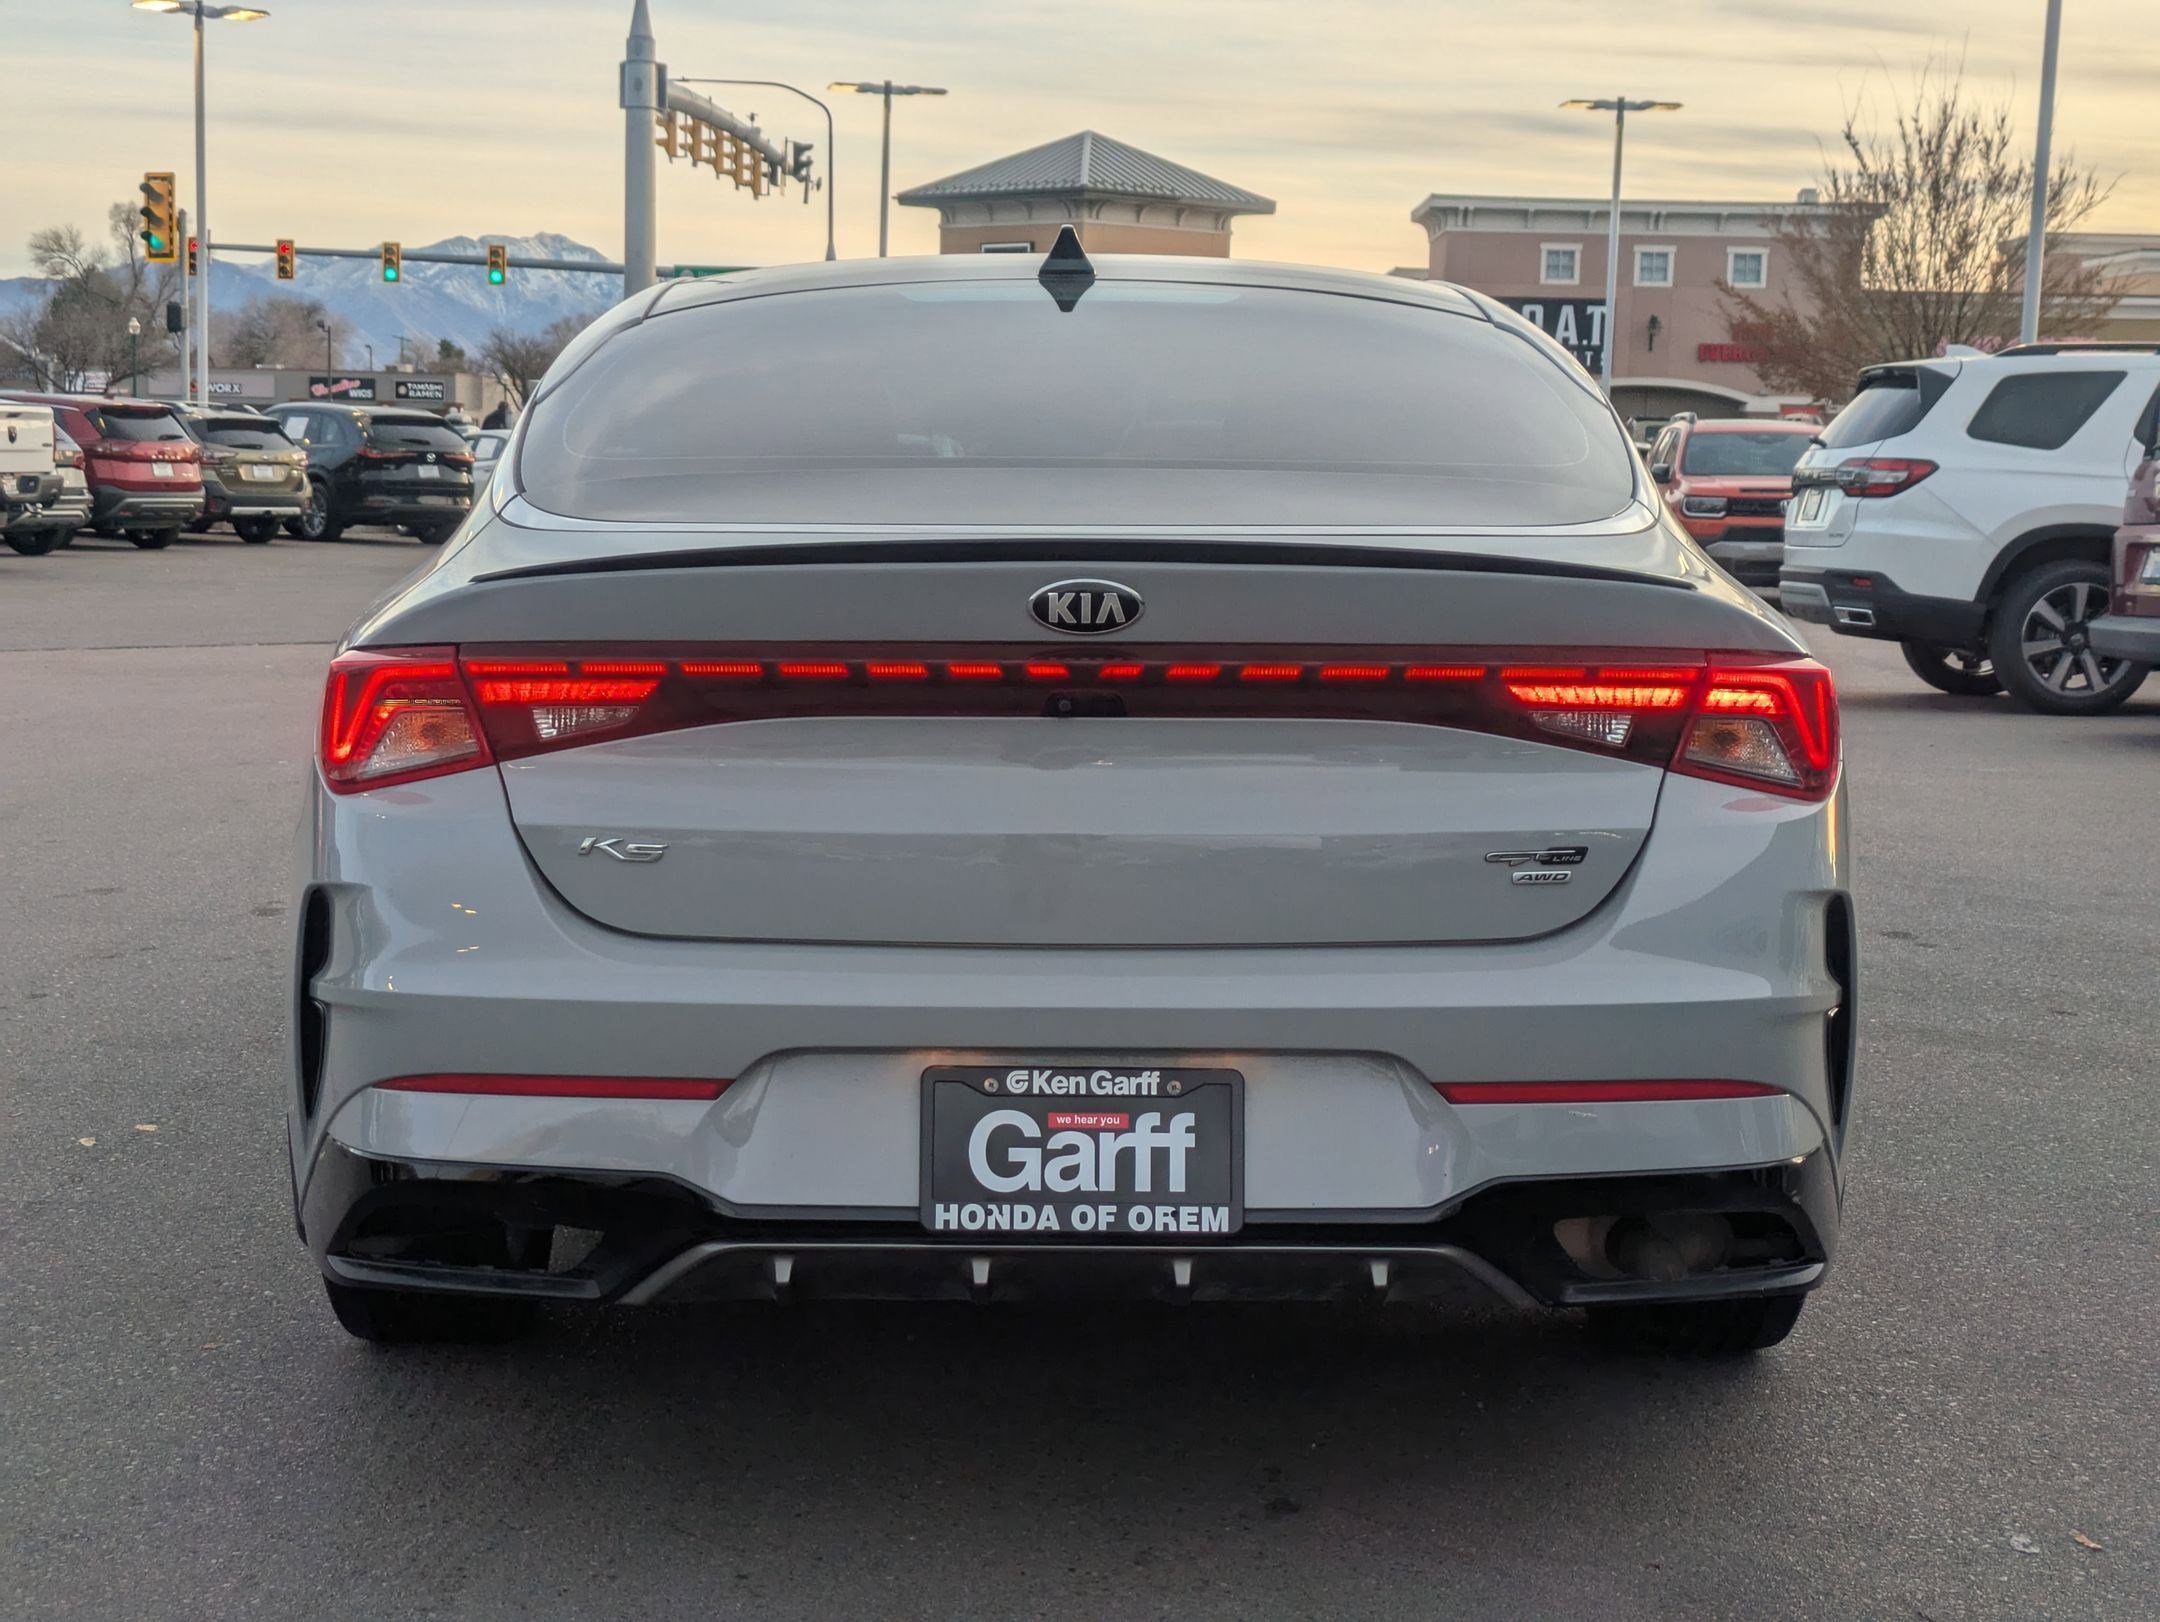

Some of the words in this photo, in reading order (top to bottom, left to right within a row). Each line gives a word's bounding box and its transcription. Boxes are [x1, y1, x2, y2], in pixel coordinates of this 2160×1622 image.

[349, 388, 373, 399] WIGS
[408, 390, 443, 399] RAMEN
[1047, 592, 1126, 624] KIA
[578, 837, 670, 863] K5
[1517, 873, 1569, 882] AWD
[1032, 1070, 1086, 1095] Ken
[1090, 1070, 1160, 1096] Garff
[1056, 1116, 1072, 1125] we
[1074, 1114, 1098, 1125] hear
[1100, 1116, 1120, 1127] you
[968, 1109, 1196, 1193] Garff
[935, 1203, 1060, 1231] HONDA
[1071, 1204, 1117, 1232] OF
[1128, 1205, 1229, 1233] OREM
